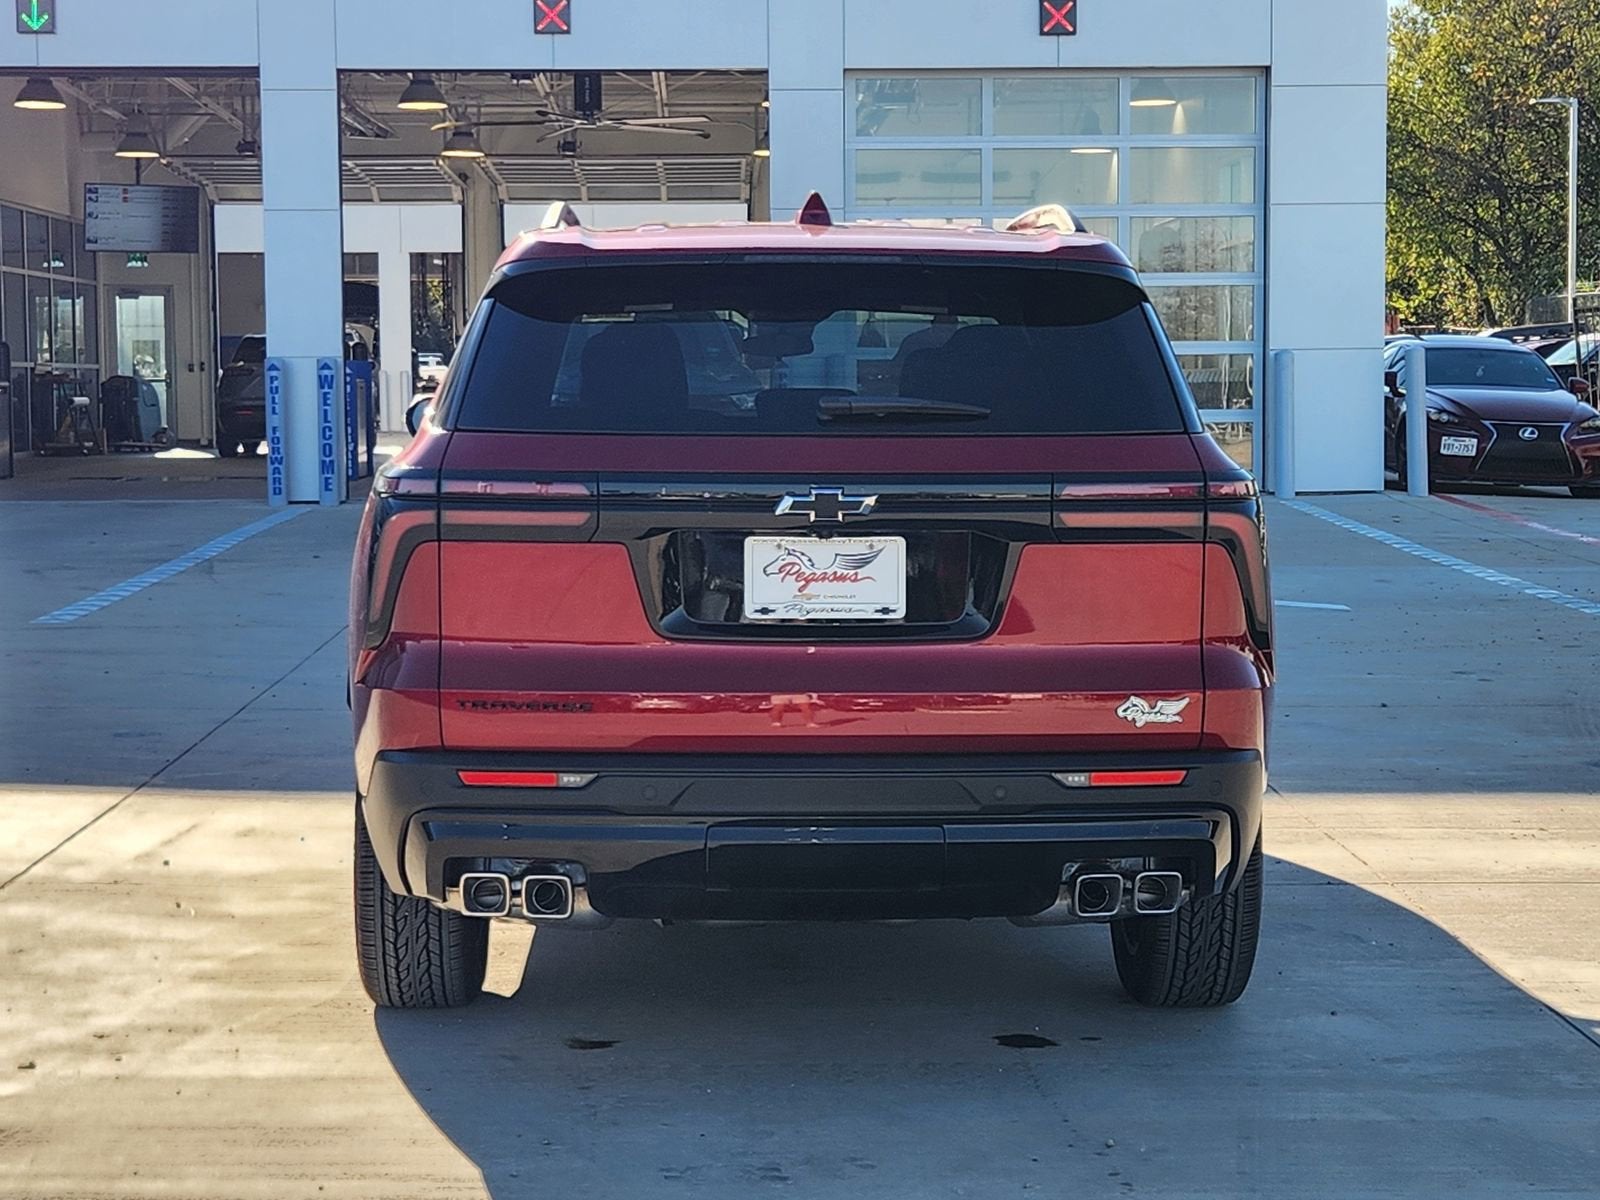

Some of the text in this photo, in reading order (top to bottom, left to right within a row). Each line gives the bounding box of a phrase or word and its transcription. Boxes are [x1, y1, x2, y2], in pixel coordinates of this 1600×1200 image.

[268, 375, 284, 496] PULL FORWARD
[318, 374, 336, 492] WELCOME
[778, 562, 876, 592] Pegasus
[457, 699, 593, 713] TRAVERSE
